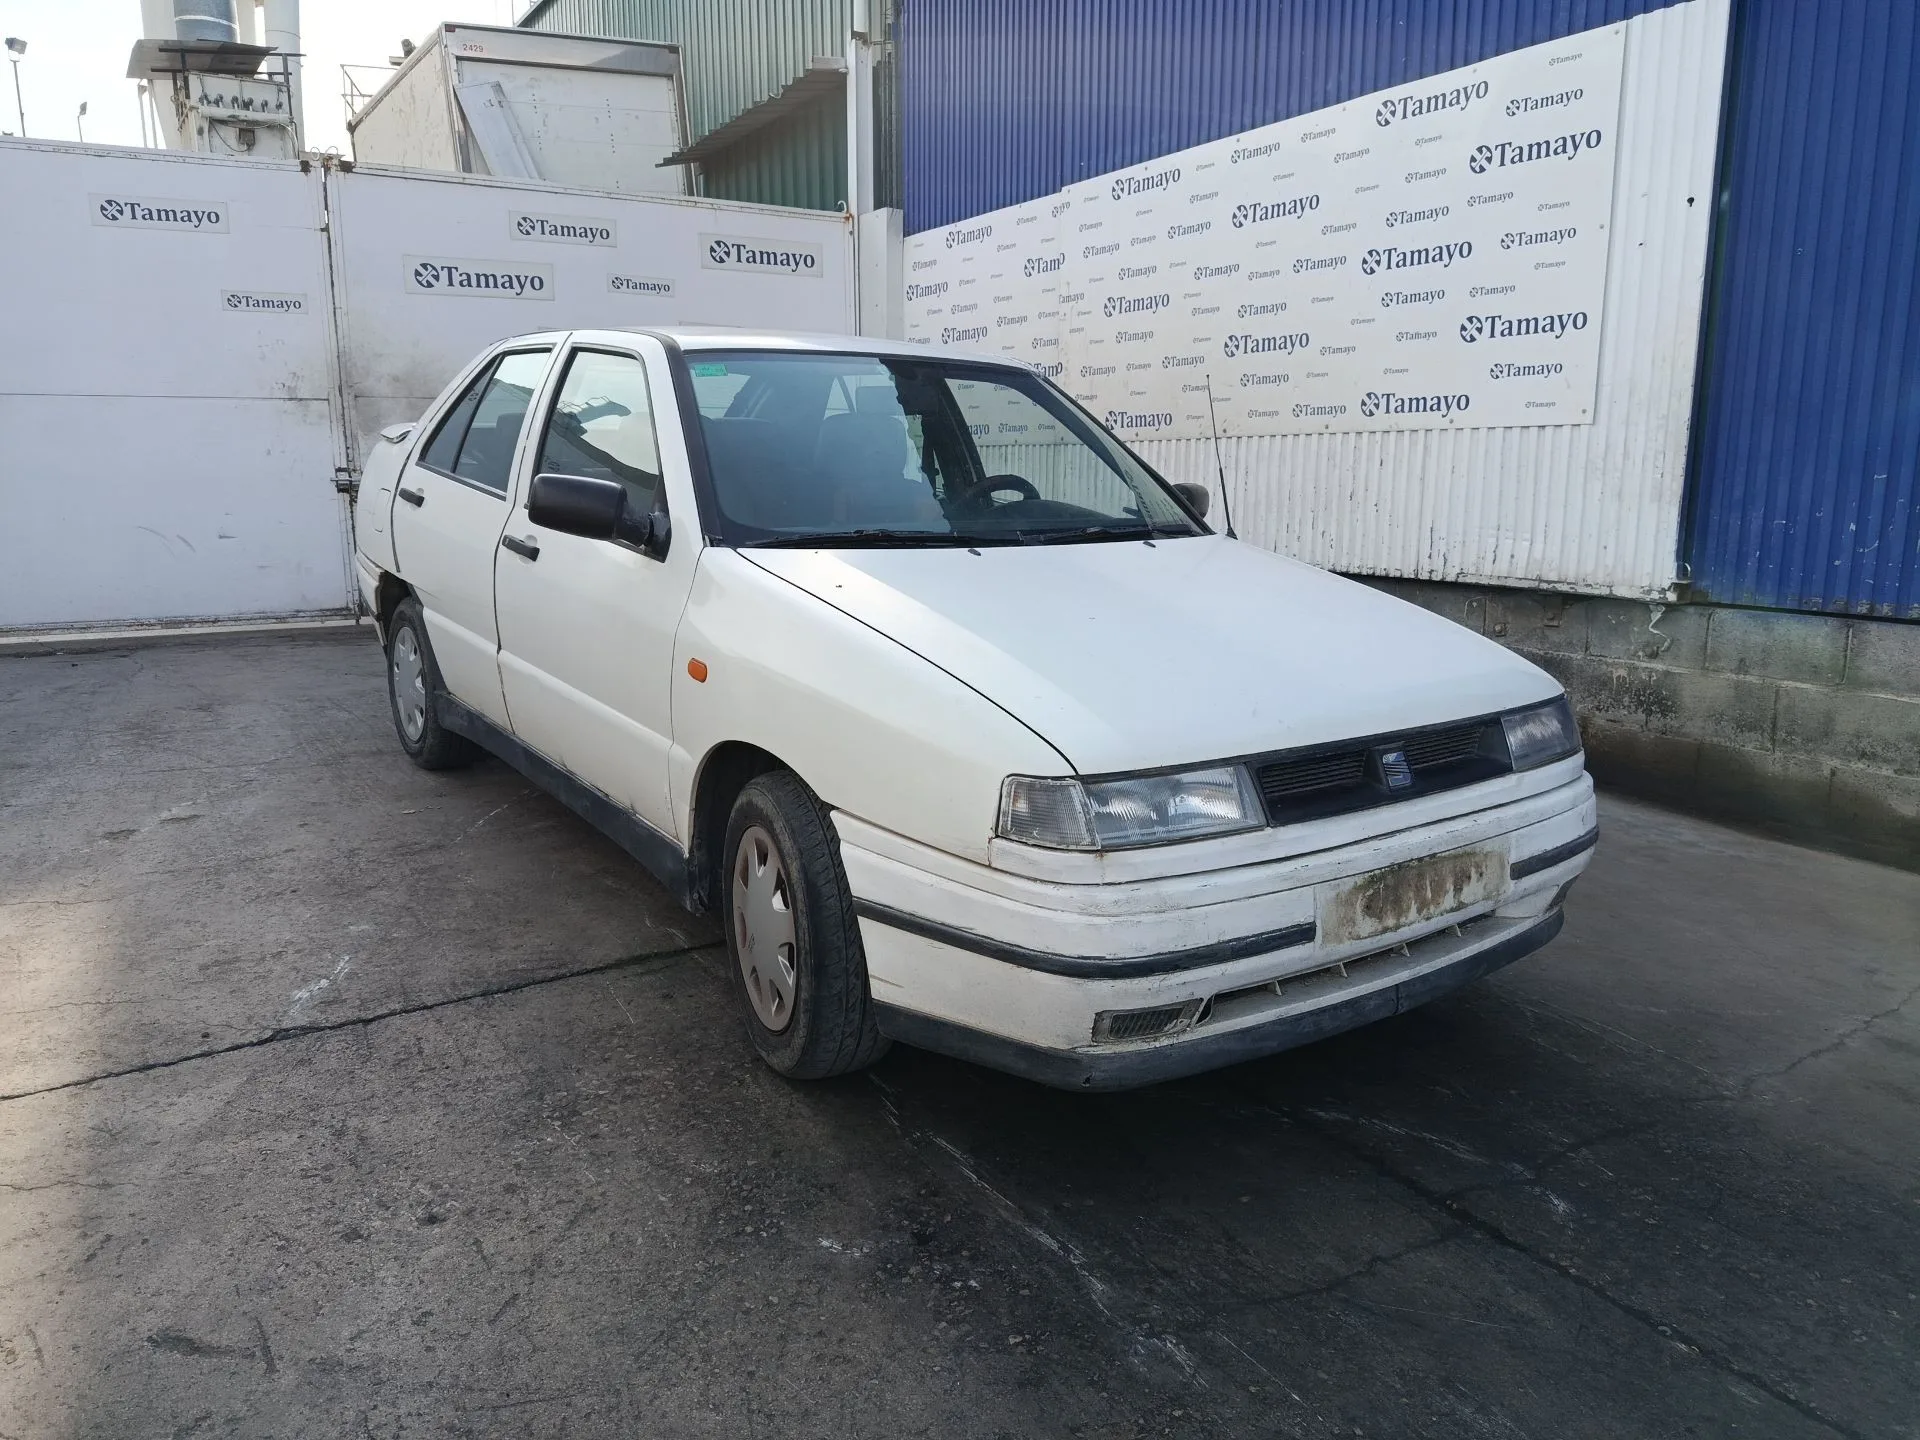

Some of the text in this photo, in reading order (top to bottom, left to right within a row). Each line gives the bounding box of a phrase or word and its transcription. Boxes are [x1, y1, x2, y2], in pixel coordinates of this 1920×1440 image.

[463, 44, 484, 52] 2429
[1556, 52, 1582, 65] Tamayo
[1398, 80, 1489, 120] Tamayo
[1521, 88, 1584, 112] Tamayo
[1308, 127, 1336, 142] Tamayo
[1242, 142, 1280, 160] Tamayo
[1341, 147, 1370, 161] Tamayo
[1494, 129, 1602, 168] Tamayo
[1125, 168, 1180, 196] Tamayo
[1414, 167, 1446, 182] Tamayo
[1477, 190, 1514, 205] Tamayo
[1544, 200, 1570, 210] Tamayo
[124, 202, 220, 228] Tamayo
[1250, 194, 1320, 223] Tamayo
[1400, 205, 1449, 224] Tamayo
[536, 220, 610, 243] Tamayo
[957, 226, 992, 246] Tamayo
[1176, 220, 1210, 237] Tamayo
[1328, 222, 1357, 236] Tamayo
[1515, 227, 1577, 247] Tamayo
[1090, 242, 1120, 256] Tamayo
[1383, 241, 1472, 270] Tamayo
[732, 244, 815, 272] Tamayo
[1304, 255, 1346, 272] Tamayo
[1540, 261, 1566, 269] Tamayo
[1126, 265, 1156, 280] Tamayo
[1203, 263, 1240, 280] Tamayo
[1255, 268, 1280, 280] Tamayo
[441, 266, 544, 296] Tamayo
[624, 278, 670, 294] Tamayo
[914, 281, 948, 298] Tamayo
[1393, 288, 1445, 305] Tamayo
[1480, 284, 1516, 296] Tamayo
[242, 296, 302, 312] Tamayo
[1117, 294, 1170, 314] Tamayo
[1248, 302, 1287, 316] Tamayo
[1485, 311, 1588, 338] Tamayo
[951, 326, 987, 343] Tamayo
[1124, 330, 1154, 342] Tamayo
[1405, 330, 1438, 341] Tamayo
[1241, 332, 1310, 354] Tamayo
[1326, 346, 1356, 356] Tamayo
[1170, 355, 1204, 368] Tamayo
[1088, 366, 1116, 377] Tamayo
[1504, 363, 1563, 378] Tamayo
[1249, 374, 1290, 388] Tamayo
[1254, 410, 1280, 418] Tamayo
[1304, 404, 1346, 417] Tamayo
[1382, 394, 1470, 418] Tamayo
[1118, 411, 1172, 432] Tamayo
